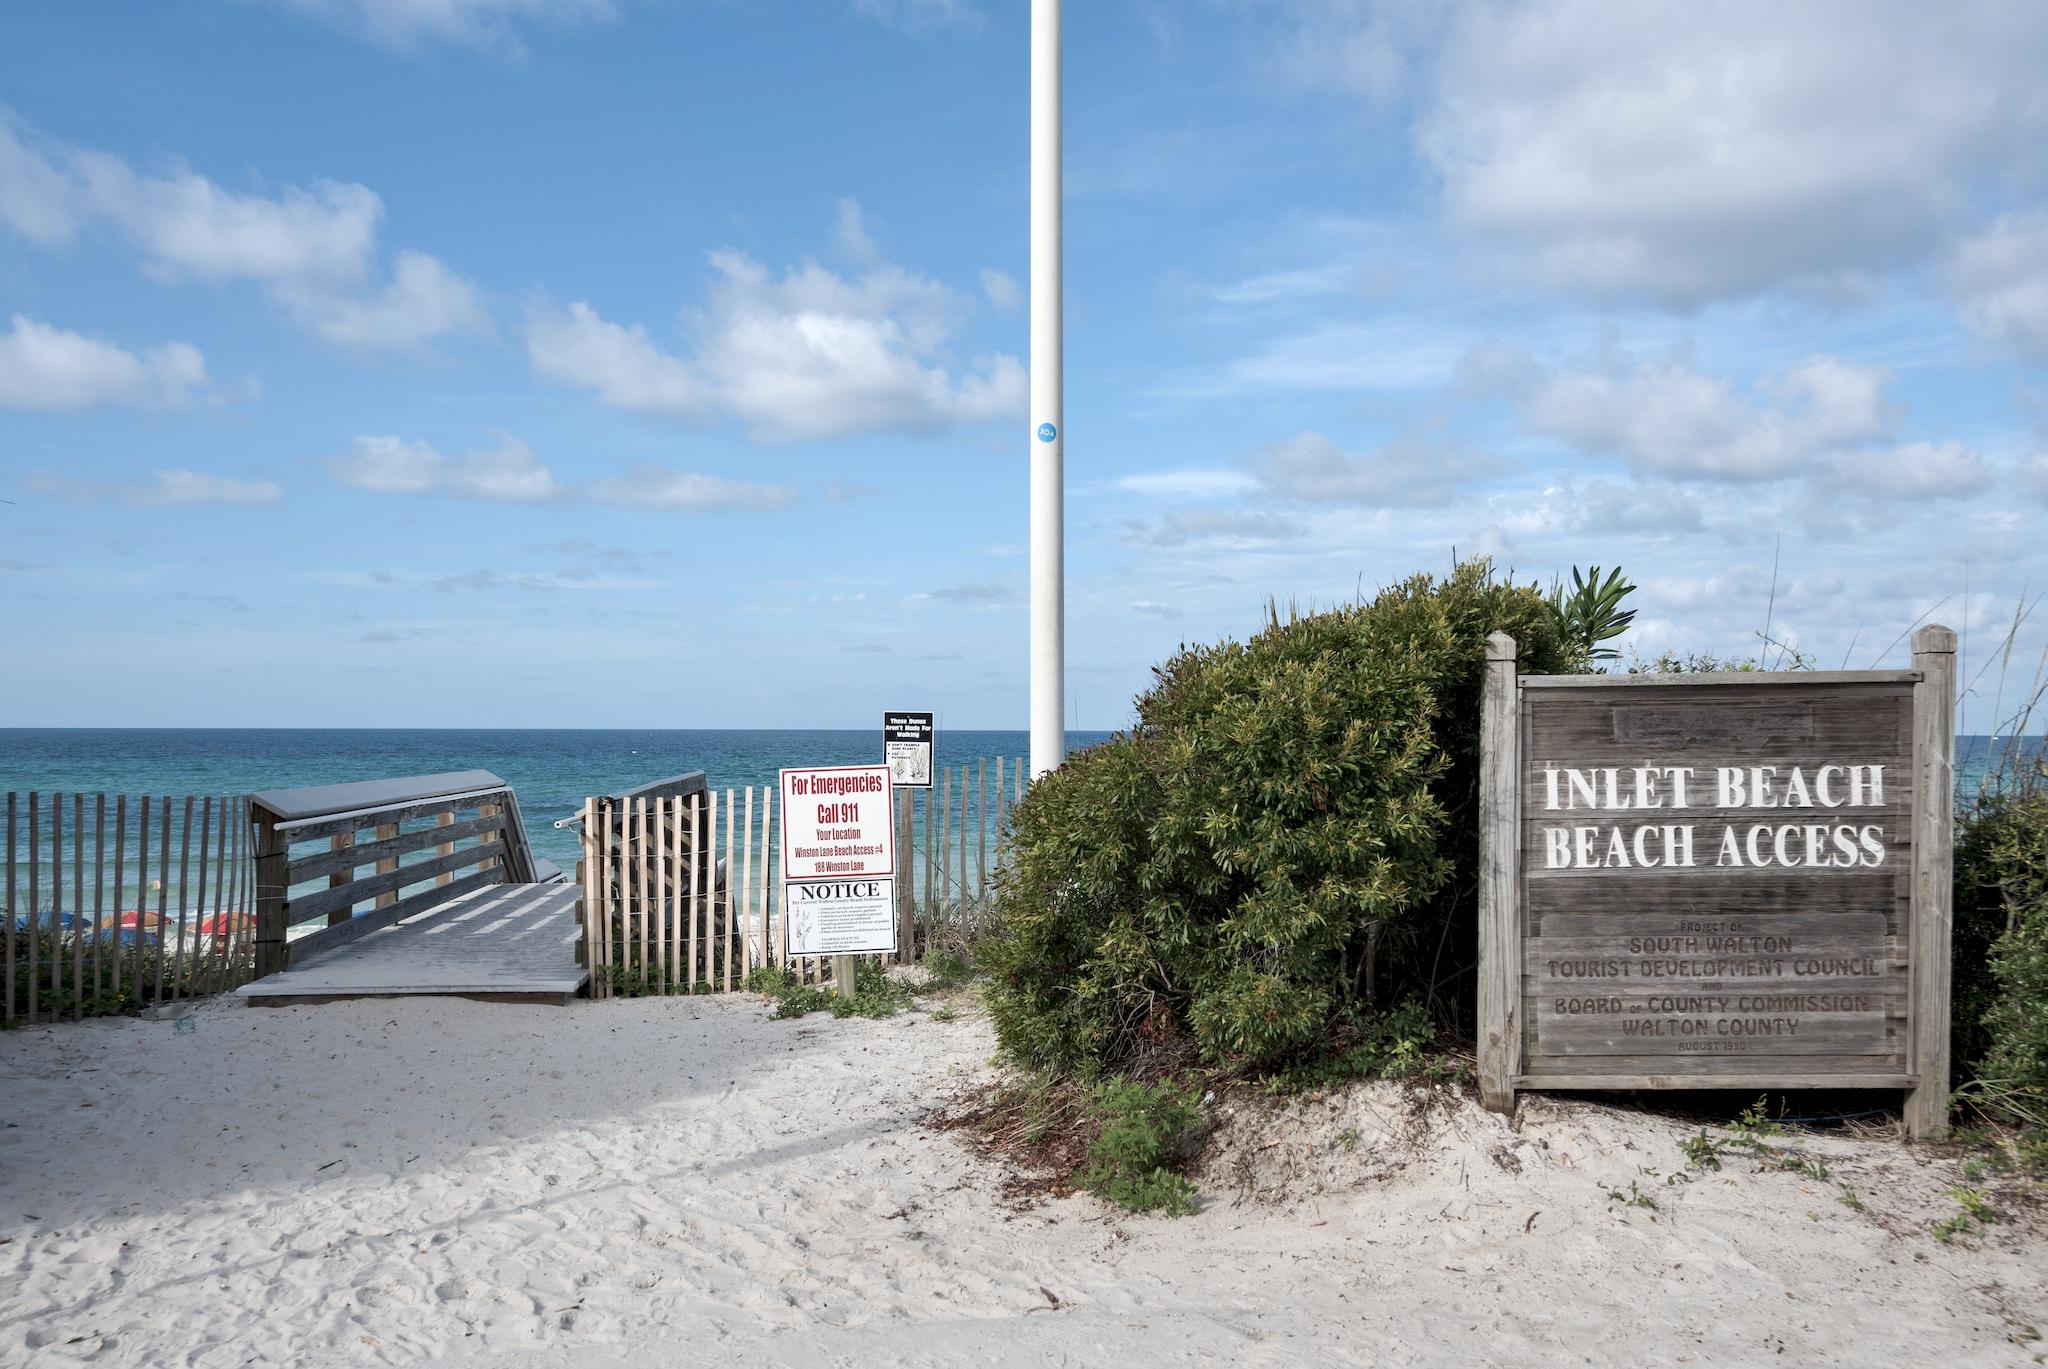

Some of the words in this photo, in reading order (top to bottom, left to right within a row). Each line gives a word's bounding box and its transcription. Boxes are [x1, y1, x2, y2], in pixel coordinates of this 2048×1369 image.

[791, 775, 808, 795] For
[811, 772, 882, 796] Emergencies
[1544, 766, 1695, 810] INLET
[1715, 764, 1886, 808] BEACH
[817, 803, 839, 824] Call
[841, 802, 859, 823] 911
[816, 828, 831, 841] Your
[832, 827, 861, 840] Location
[795, 846, 819, 858] Winston
[819, 846, 834, 857] Lane
[834, 845, 853, 856] Beach
[853, 844, 874, 855] Access
[874, 843, 883, 855] #4
[1544, 824, 1696, 869] BEACH
[1715, 823, 1885, 868] ACCESS
[825, 861, 850, 872] Winston
[850, 860, 864, 871] Lane
[800, 882, 880, 900] NOTICE
[1680, 922, 1725, 932] PROJECT
[1629, 937, 1698, 954] SOUTH
[1706, 936, 1792, 953] WALTON
[1547, 960, 1633, 977] TOURIST
[1640, 959, 1784, 977] DEVELOPMENT
[1793, 958, 1880, 976] COUNCIL
[1701, 982, 1723, 991] AND
[1555, 997, 1622, 1015] BOARD
[1629, 1005, 1642, 1014] OF
[1648, 996, 1729, 1014] COUNTY
[1738, 996, 1870, 1013] COMMISSION
[1622, 1019, 1708, 1036] WALTON
[1717, 1018, 1799, 1035] COUNTY
[1678, 1042, 1723, 1051] AUGUST
[1724, 1041, 1746, 1051] 1990
